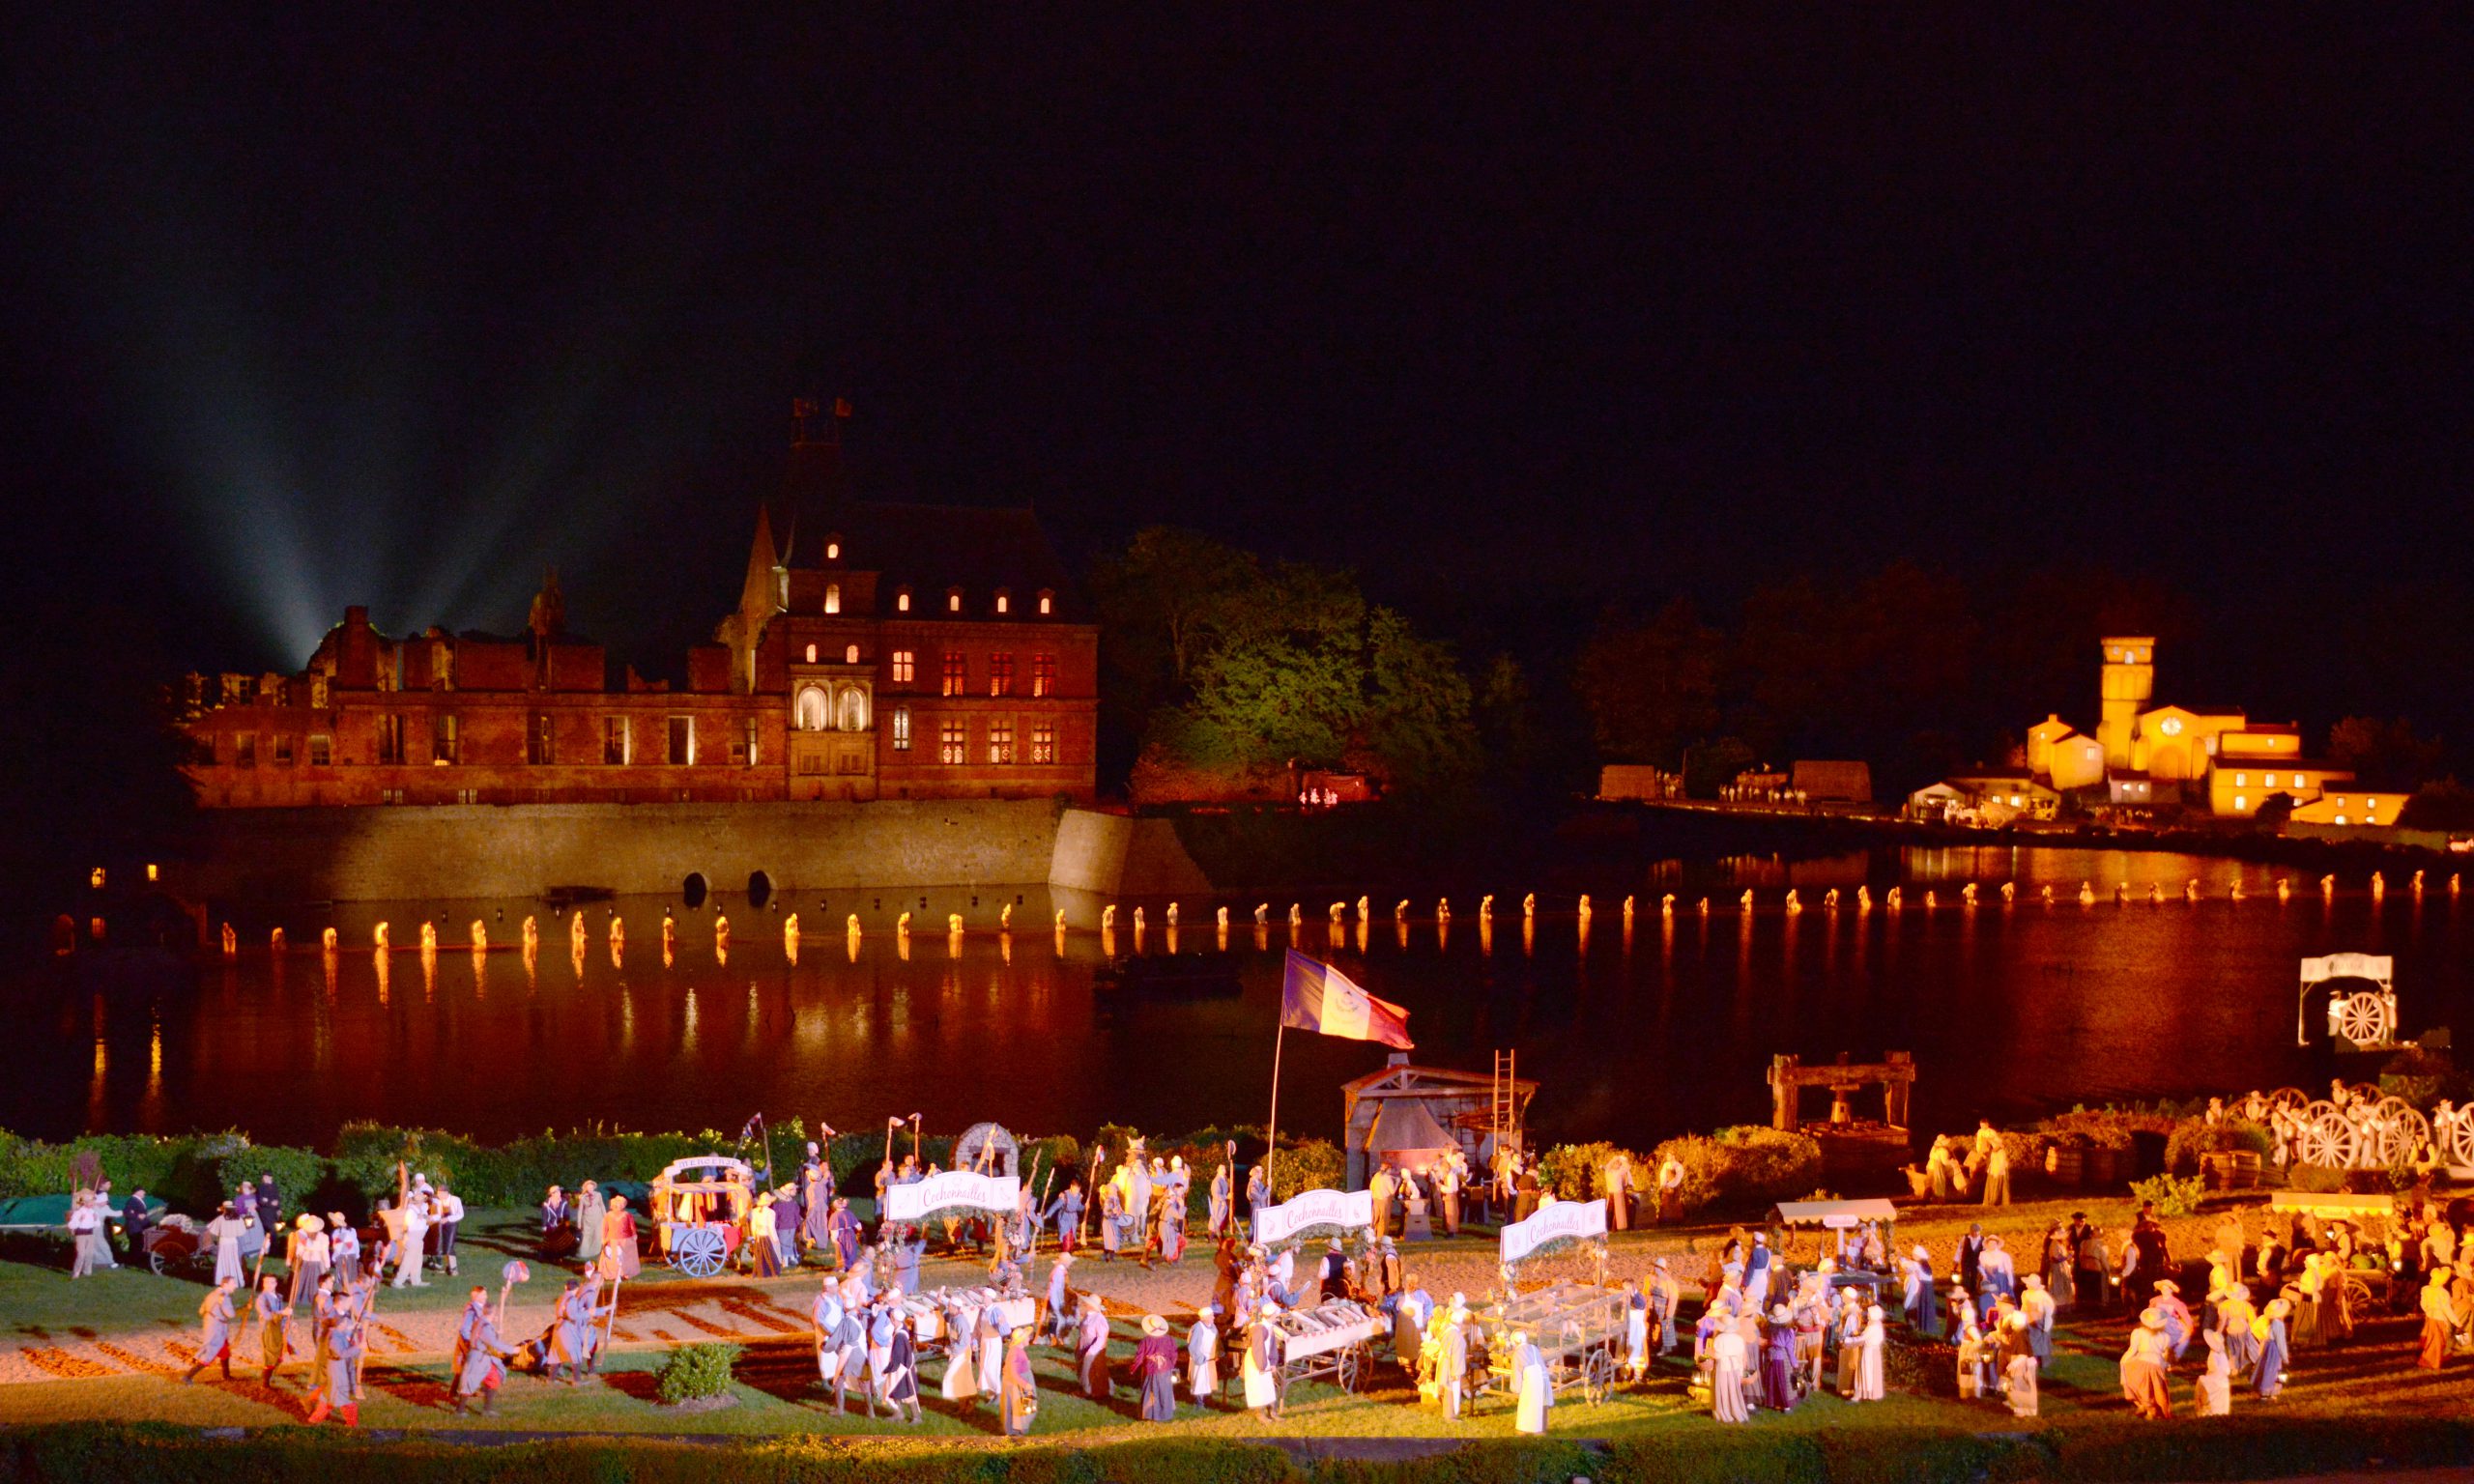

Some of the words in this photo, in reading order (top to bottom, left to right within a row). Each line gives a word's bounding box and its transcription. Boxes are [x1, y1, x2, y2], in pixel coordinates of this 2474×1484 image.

[924, 1183, 987, 1207] Cochonnailles
[1288, 1201, 1342, 1228] Cochonnailles
[1531, 1213, 1579, 1242] Cochonnailles
